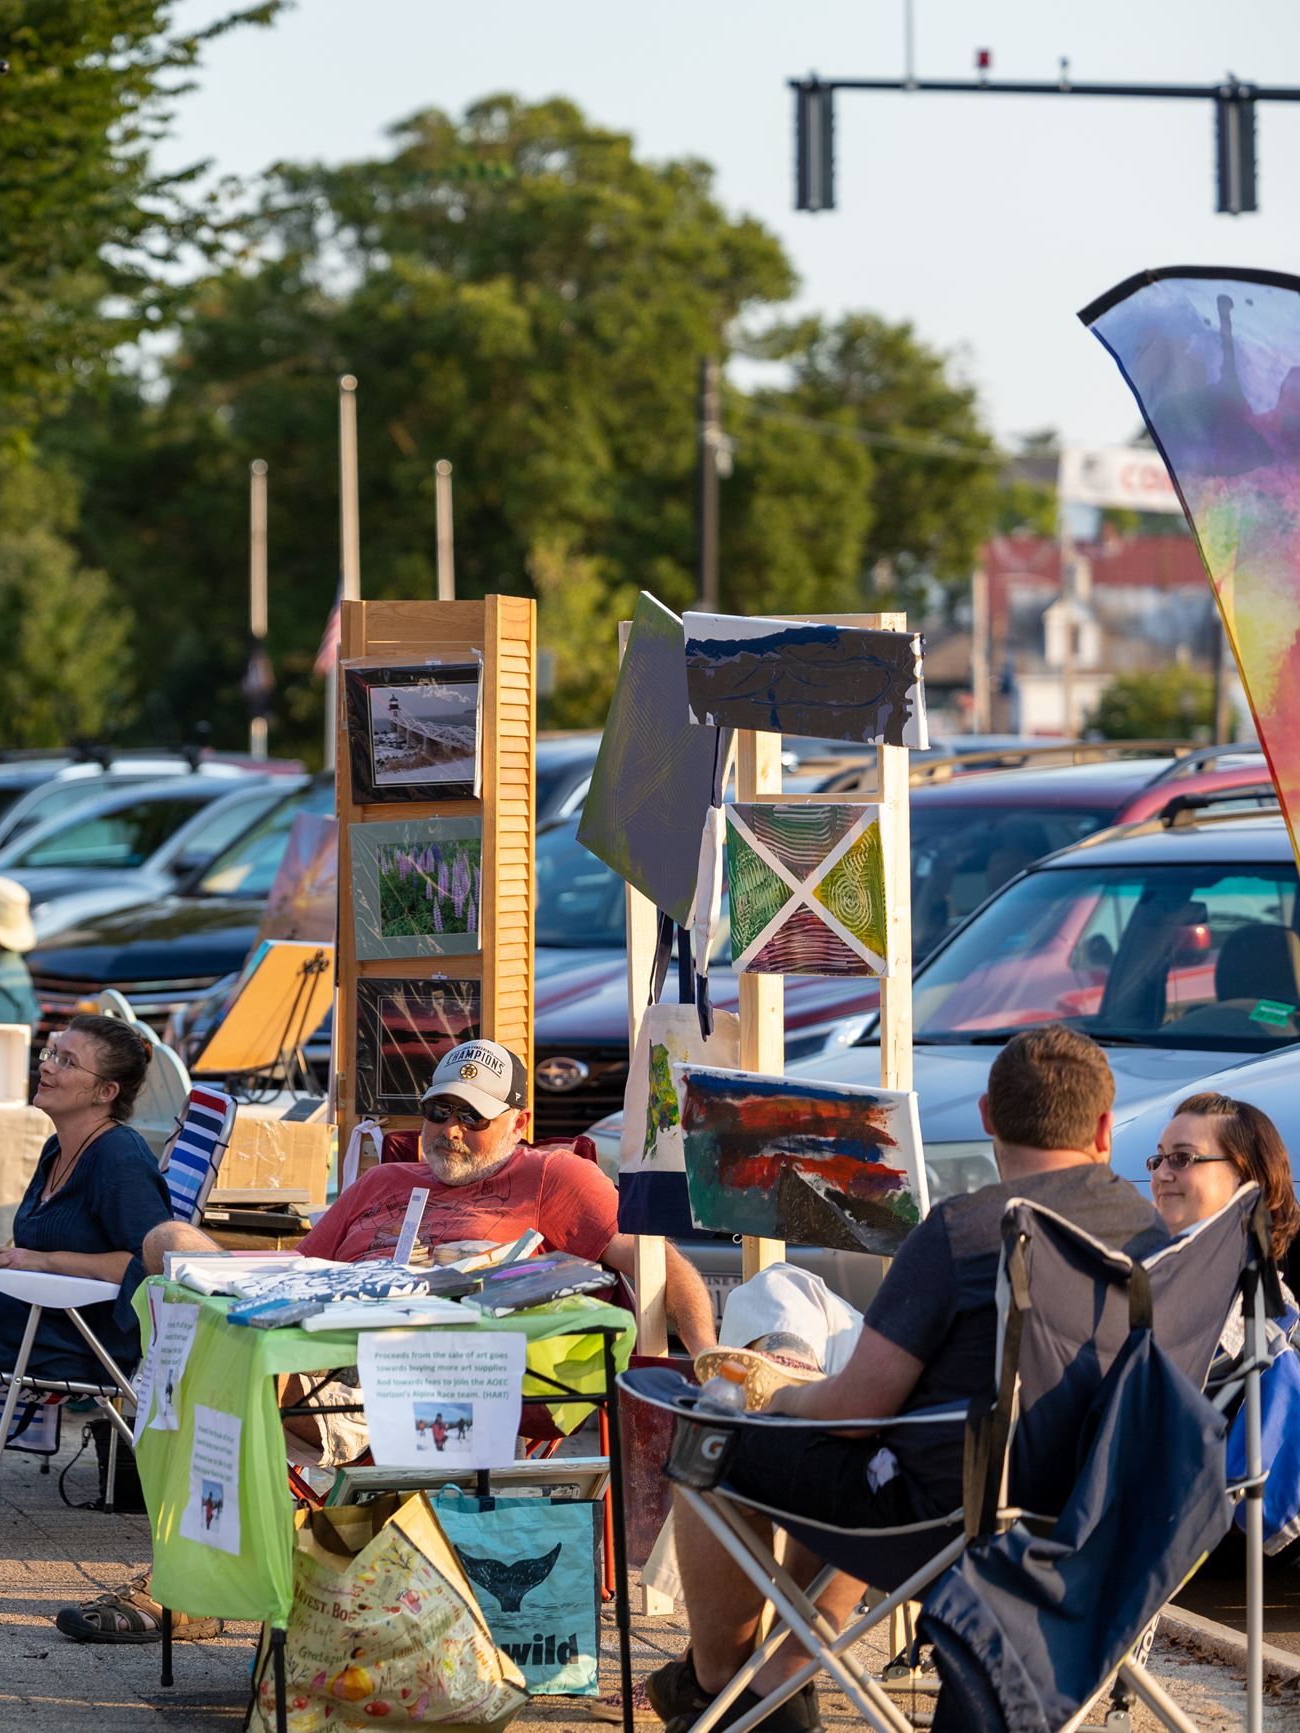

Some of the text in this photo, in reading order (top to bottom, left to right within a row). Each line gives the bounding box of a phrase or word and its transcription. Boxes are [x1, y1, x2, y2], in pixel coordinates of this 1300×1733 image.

[446, 1049, 505, 1075] CHAMPIONS
[412, 1351, 431, 1359] from
[433, 1351, 445, 1359] the
[449, 1351, 463, 1359] sale
[466, 1350, 474, 1359] of
[409, 1364, 435, 1372] buying
[474, 1364, 507, 1372] supplies
[453, 1378, 468, 1387] join
[500, 1632, 579, 1666] wild
